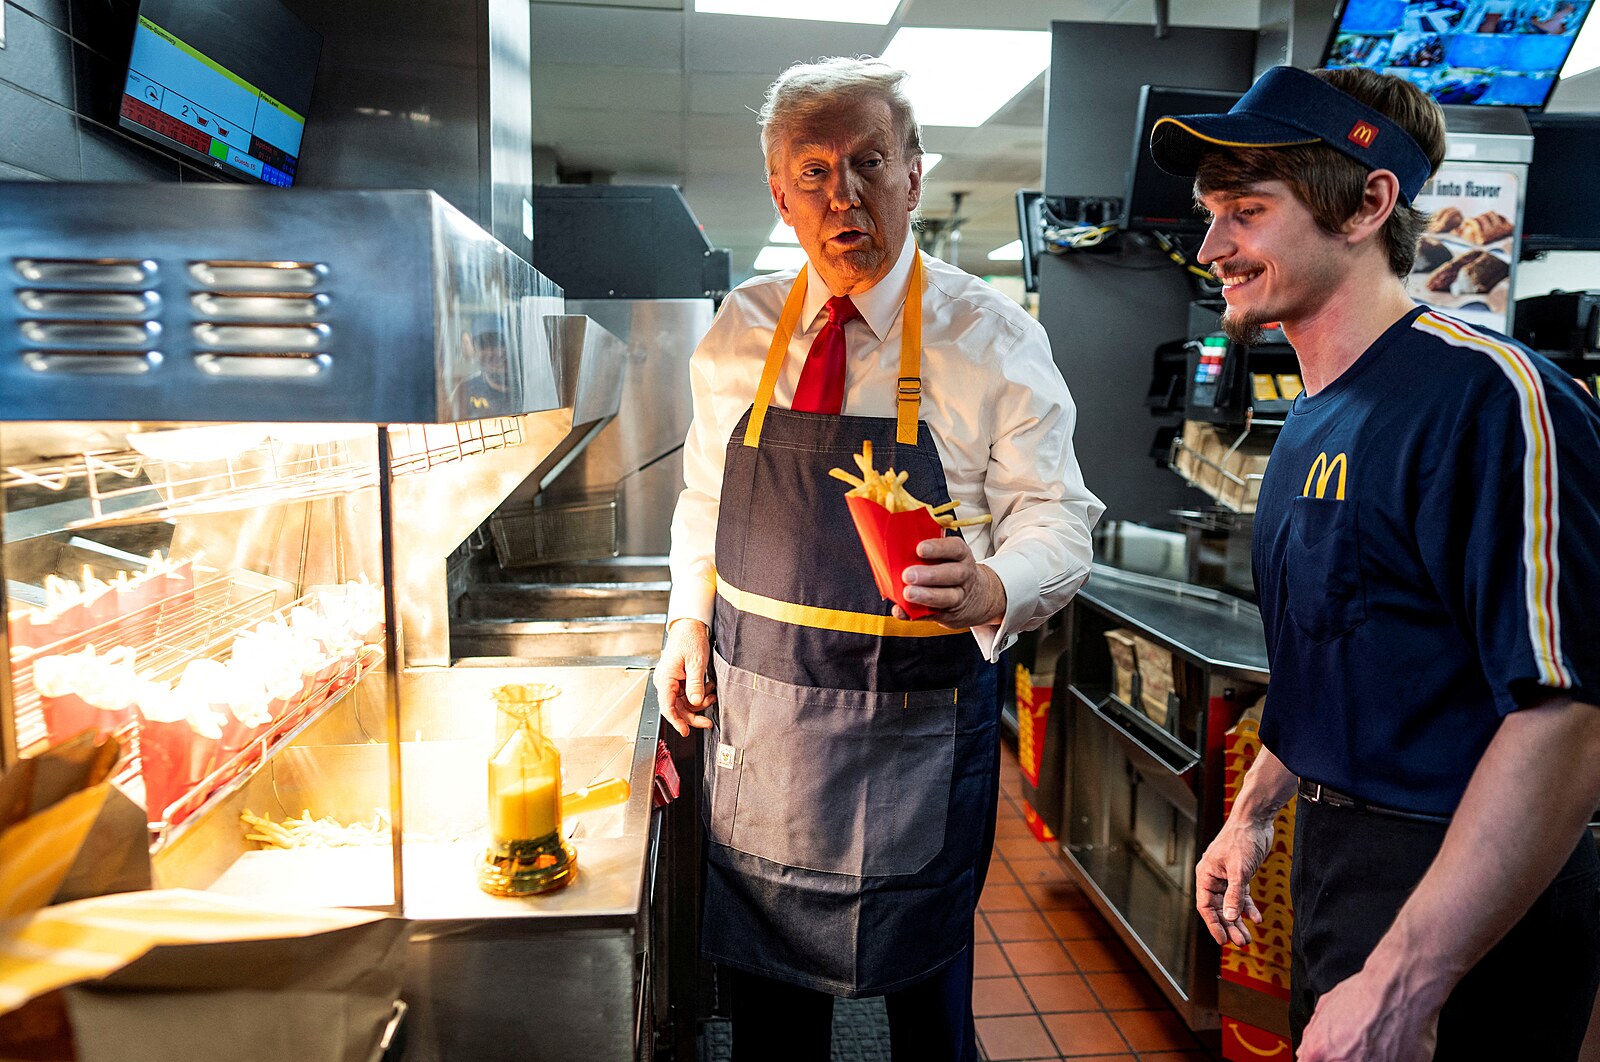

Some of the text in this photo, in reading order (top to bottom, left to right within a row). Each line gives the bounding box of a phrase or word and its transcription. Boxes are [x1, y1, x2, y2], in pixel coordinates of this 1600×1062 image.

[181, 104, 188, 117] 2
[1436, 180, 1462, 197] into
[1465, 181, 1501, 198] flavor
